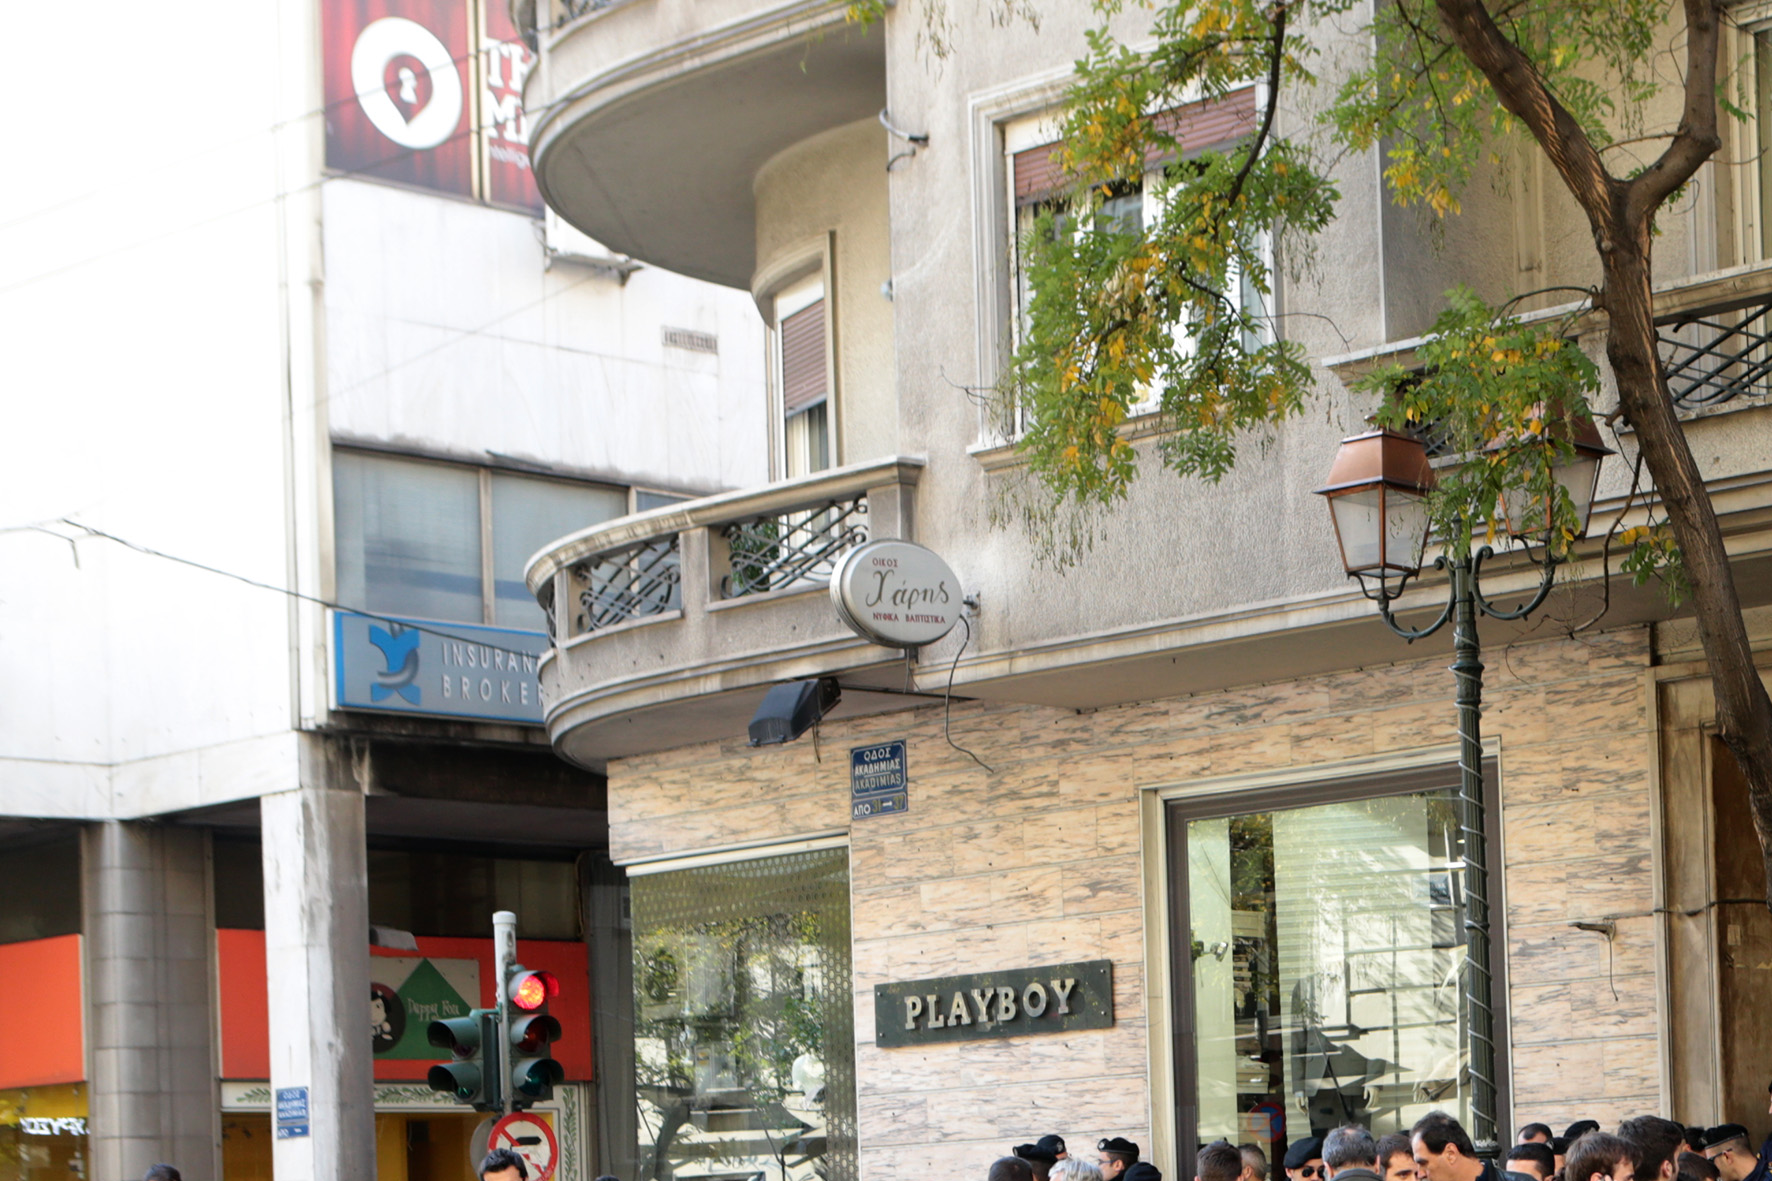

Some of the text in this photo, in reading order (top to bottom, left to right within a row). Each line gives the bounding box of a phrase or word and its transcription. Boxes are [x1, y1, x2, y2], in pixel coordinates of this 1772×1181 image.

[872, 558, 898, 568] ΟΙΚΟΣ
[866, 569, 949, 610] Χάρης
[873, 612, 946, 624] ΝΥΦΙΚΑ ΒΑΠΤΙΣΤΙΚΑ
[442, 641, 540, 674] INSURAN
[855, 758, 901, 776] ΑΚΑΔΗΜΙΑΣ
[855, 773, 901, 790] AKADIMIAS
[854, 803, 871, 816] ΑΠΟ
[904, 978, 1075, 1031] PLAYBOY
